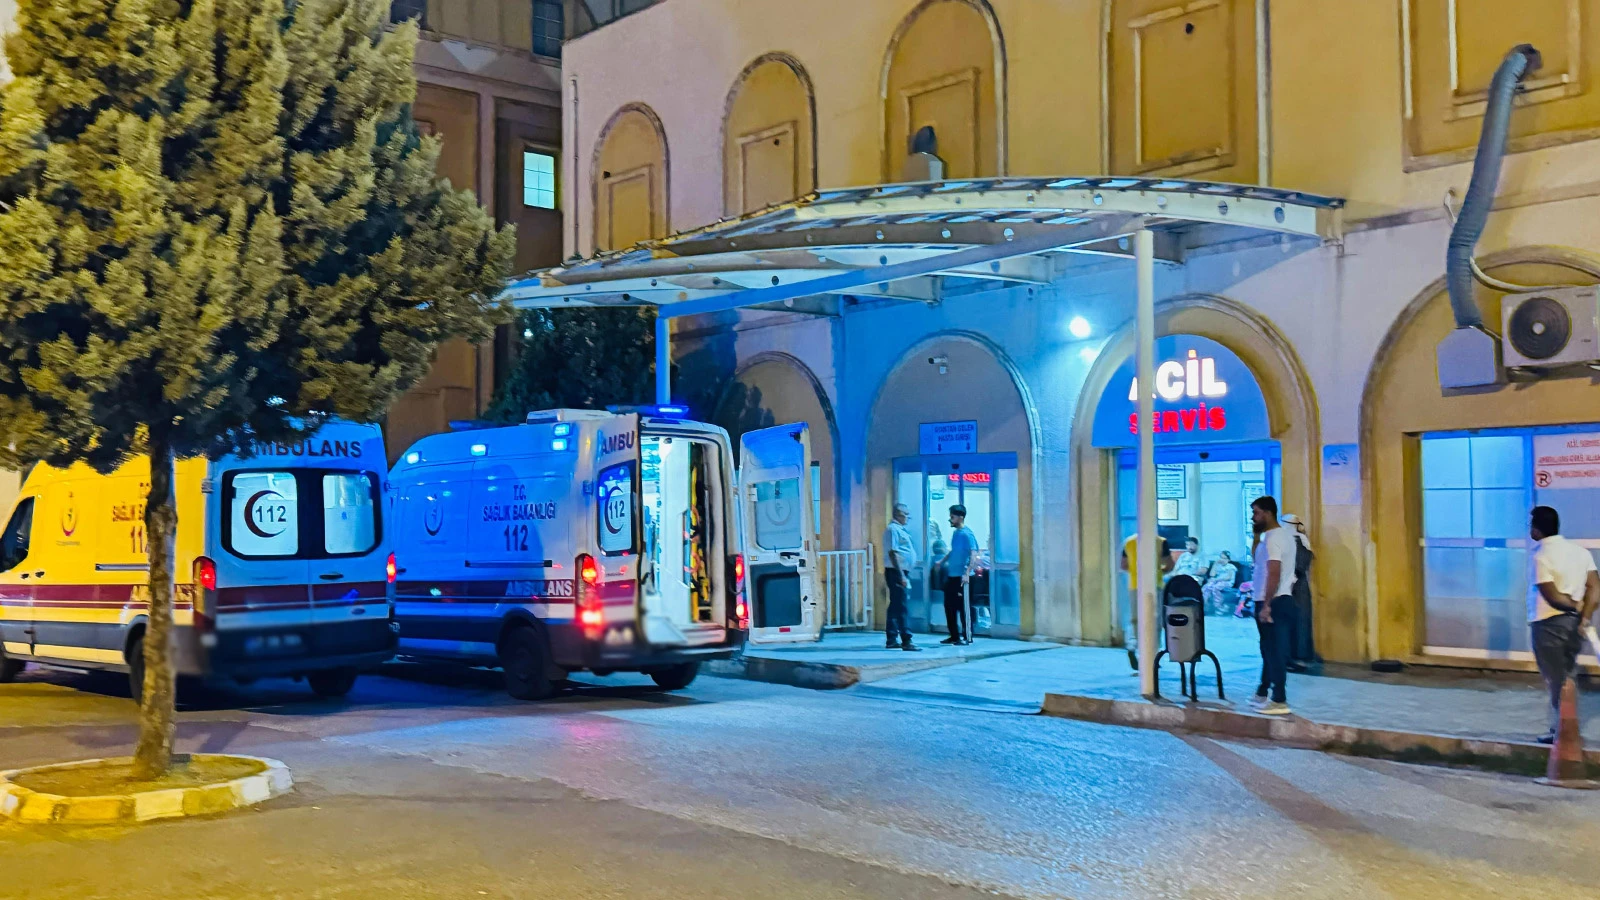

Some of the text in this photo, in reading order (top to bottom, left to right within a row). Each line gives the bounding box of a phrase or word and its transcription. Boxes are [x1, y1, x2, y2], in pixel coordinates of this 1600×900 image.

[513, 484, 527, 501] T.C.
[256, 505, 287, 522] 112
[609, 499, 625, 520] 112
[504, 524, 529, 551] 112
